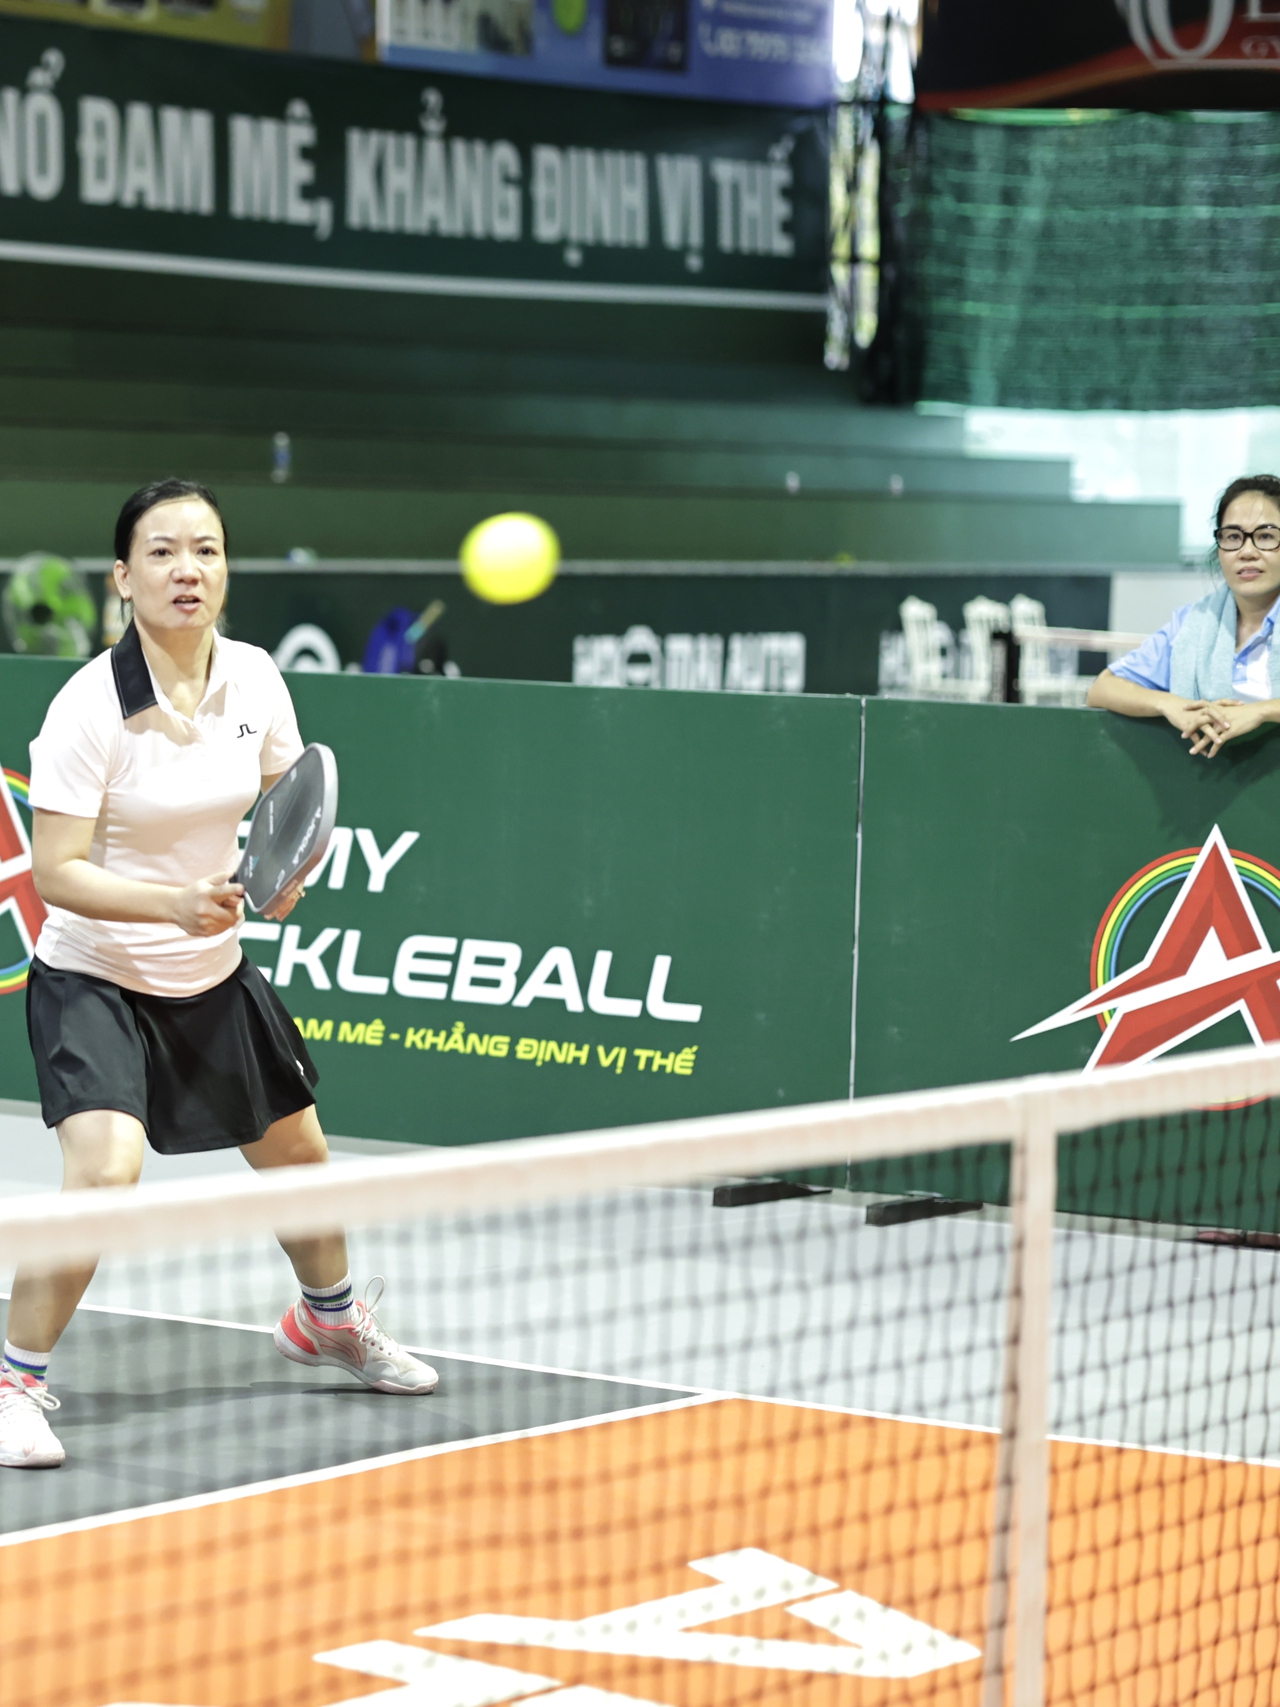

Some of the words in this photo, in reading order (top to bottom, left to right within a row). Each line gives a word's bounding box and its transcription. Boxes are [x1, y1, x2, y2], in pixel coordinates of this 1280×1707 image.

[76, 95, 215, 215] ĐAM
[228, 99, 332, 240] MÊ,
[346, 86, 522, 242] KHẲNG
[531, 142, 649, 267] ĐỊNH
[655, 153, 704, 273] VỊ
[710, 134, 796, 258] THẾ
[337, 1018, 386, 1046] MÊ
[404, 1021, 511, 1058] KHẲNG
[515, 1037, 590, 1067] ĐỊNH
[596, 1045, 627, 1074] VỊ
[633, 1045, 699, 1075] THẾ
